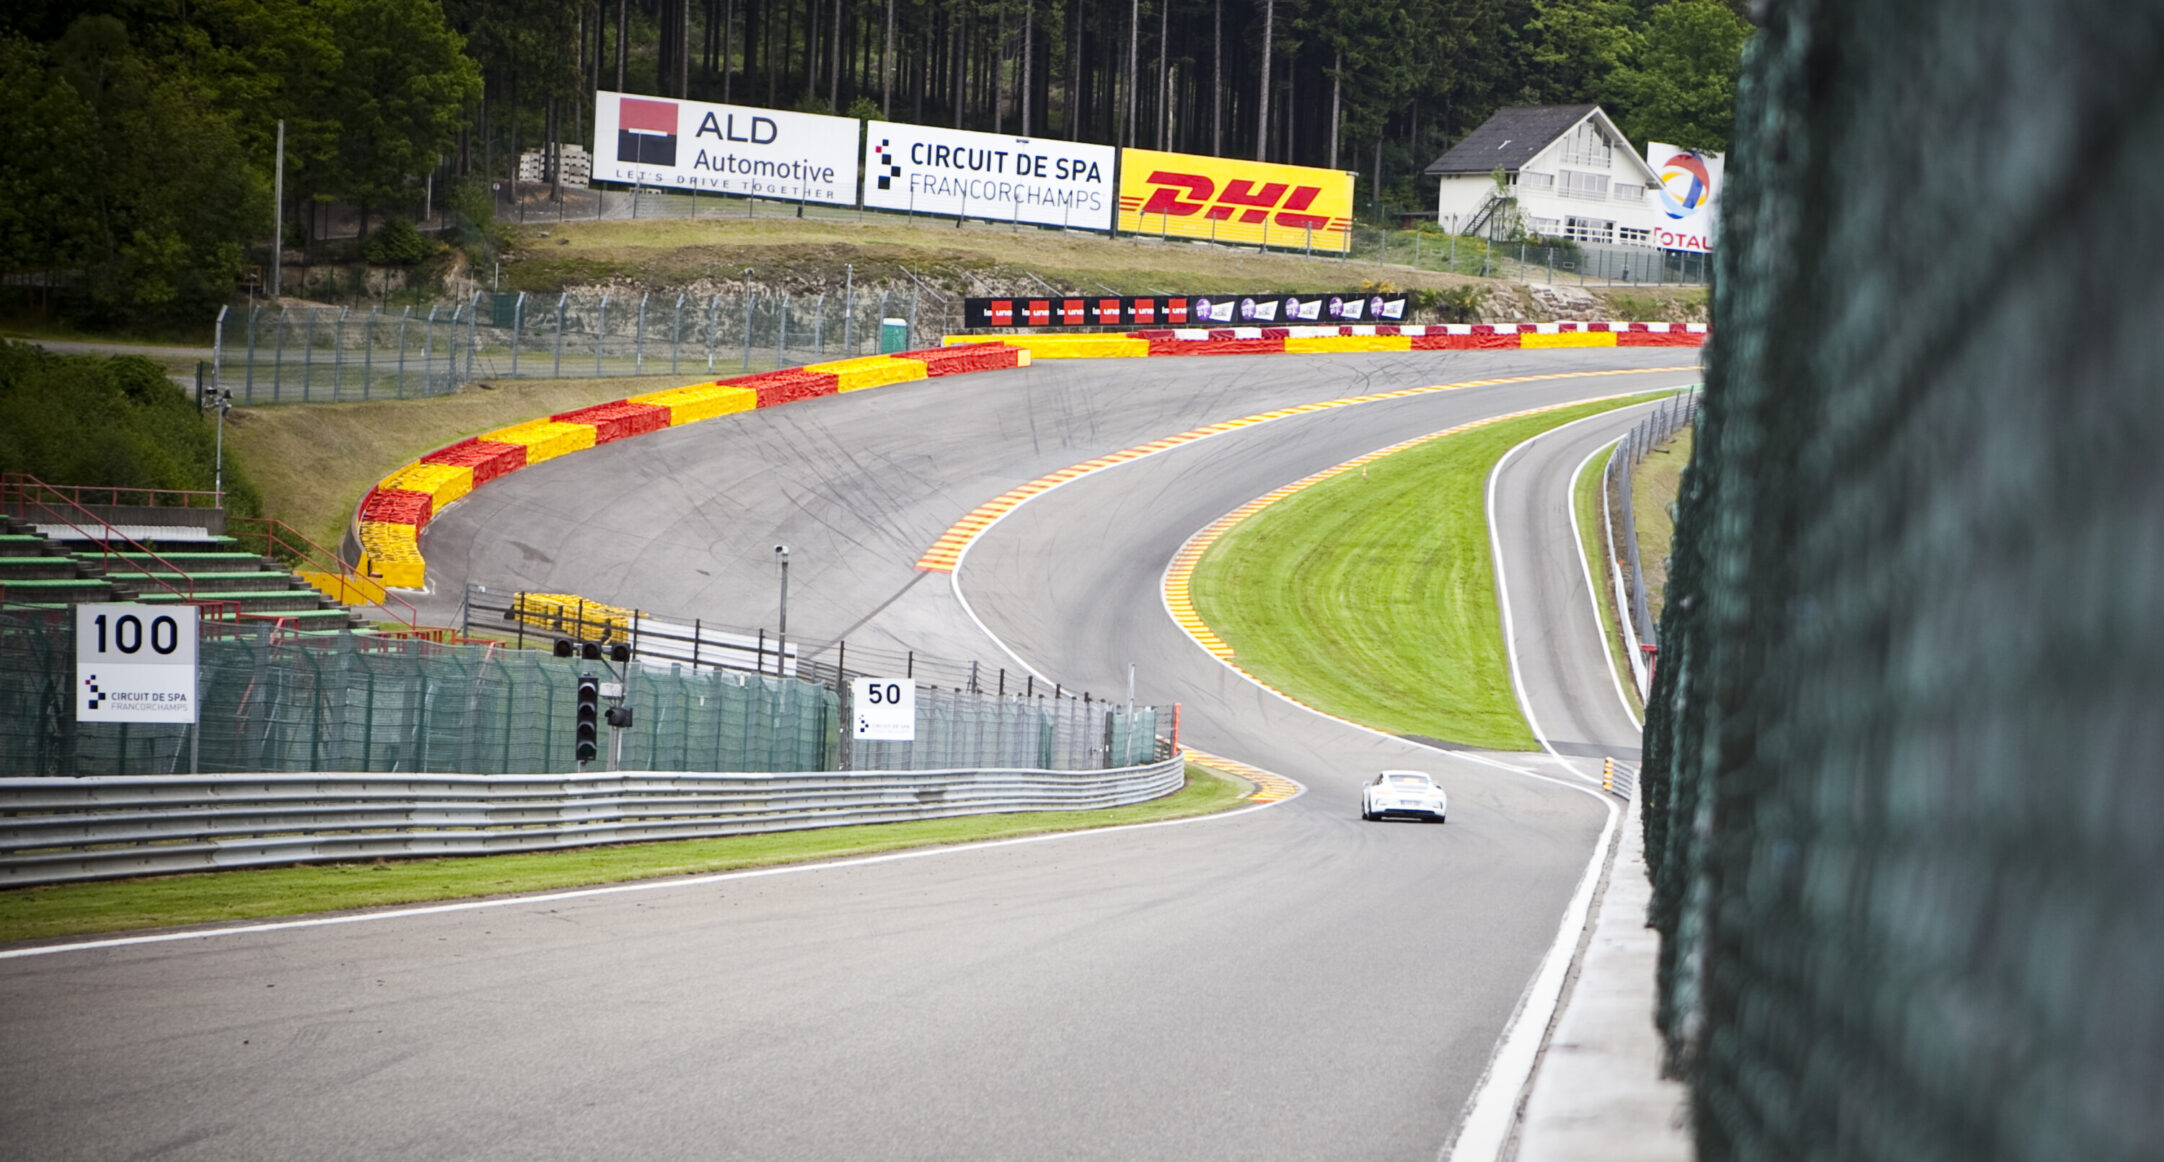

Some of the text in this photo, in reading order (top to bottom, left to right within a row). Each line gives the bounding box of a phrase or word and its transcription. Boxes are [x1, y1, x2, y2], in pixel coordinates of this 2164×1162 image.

[695, 111, 778, 145] ALD
[694, 149, 835, 183] Automotive
[911, 142, 1102, 183] CIRCUIT DE SPA
[616, 169, 835, 199] LET'S DRIVE TOGETHER
[910, 173, 1102, 211] FRANCORCHAMPS
[1143, 170, 1331, 230] DHL
[95, 614, 178, 655] 100
[111, 692, 187, 702] CIRCUIT DE SPA
[111, 702, 189, 712] FRANCORCHAMPS
[869, 684, 901, 705] 50
